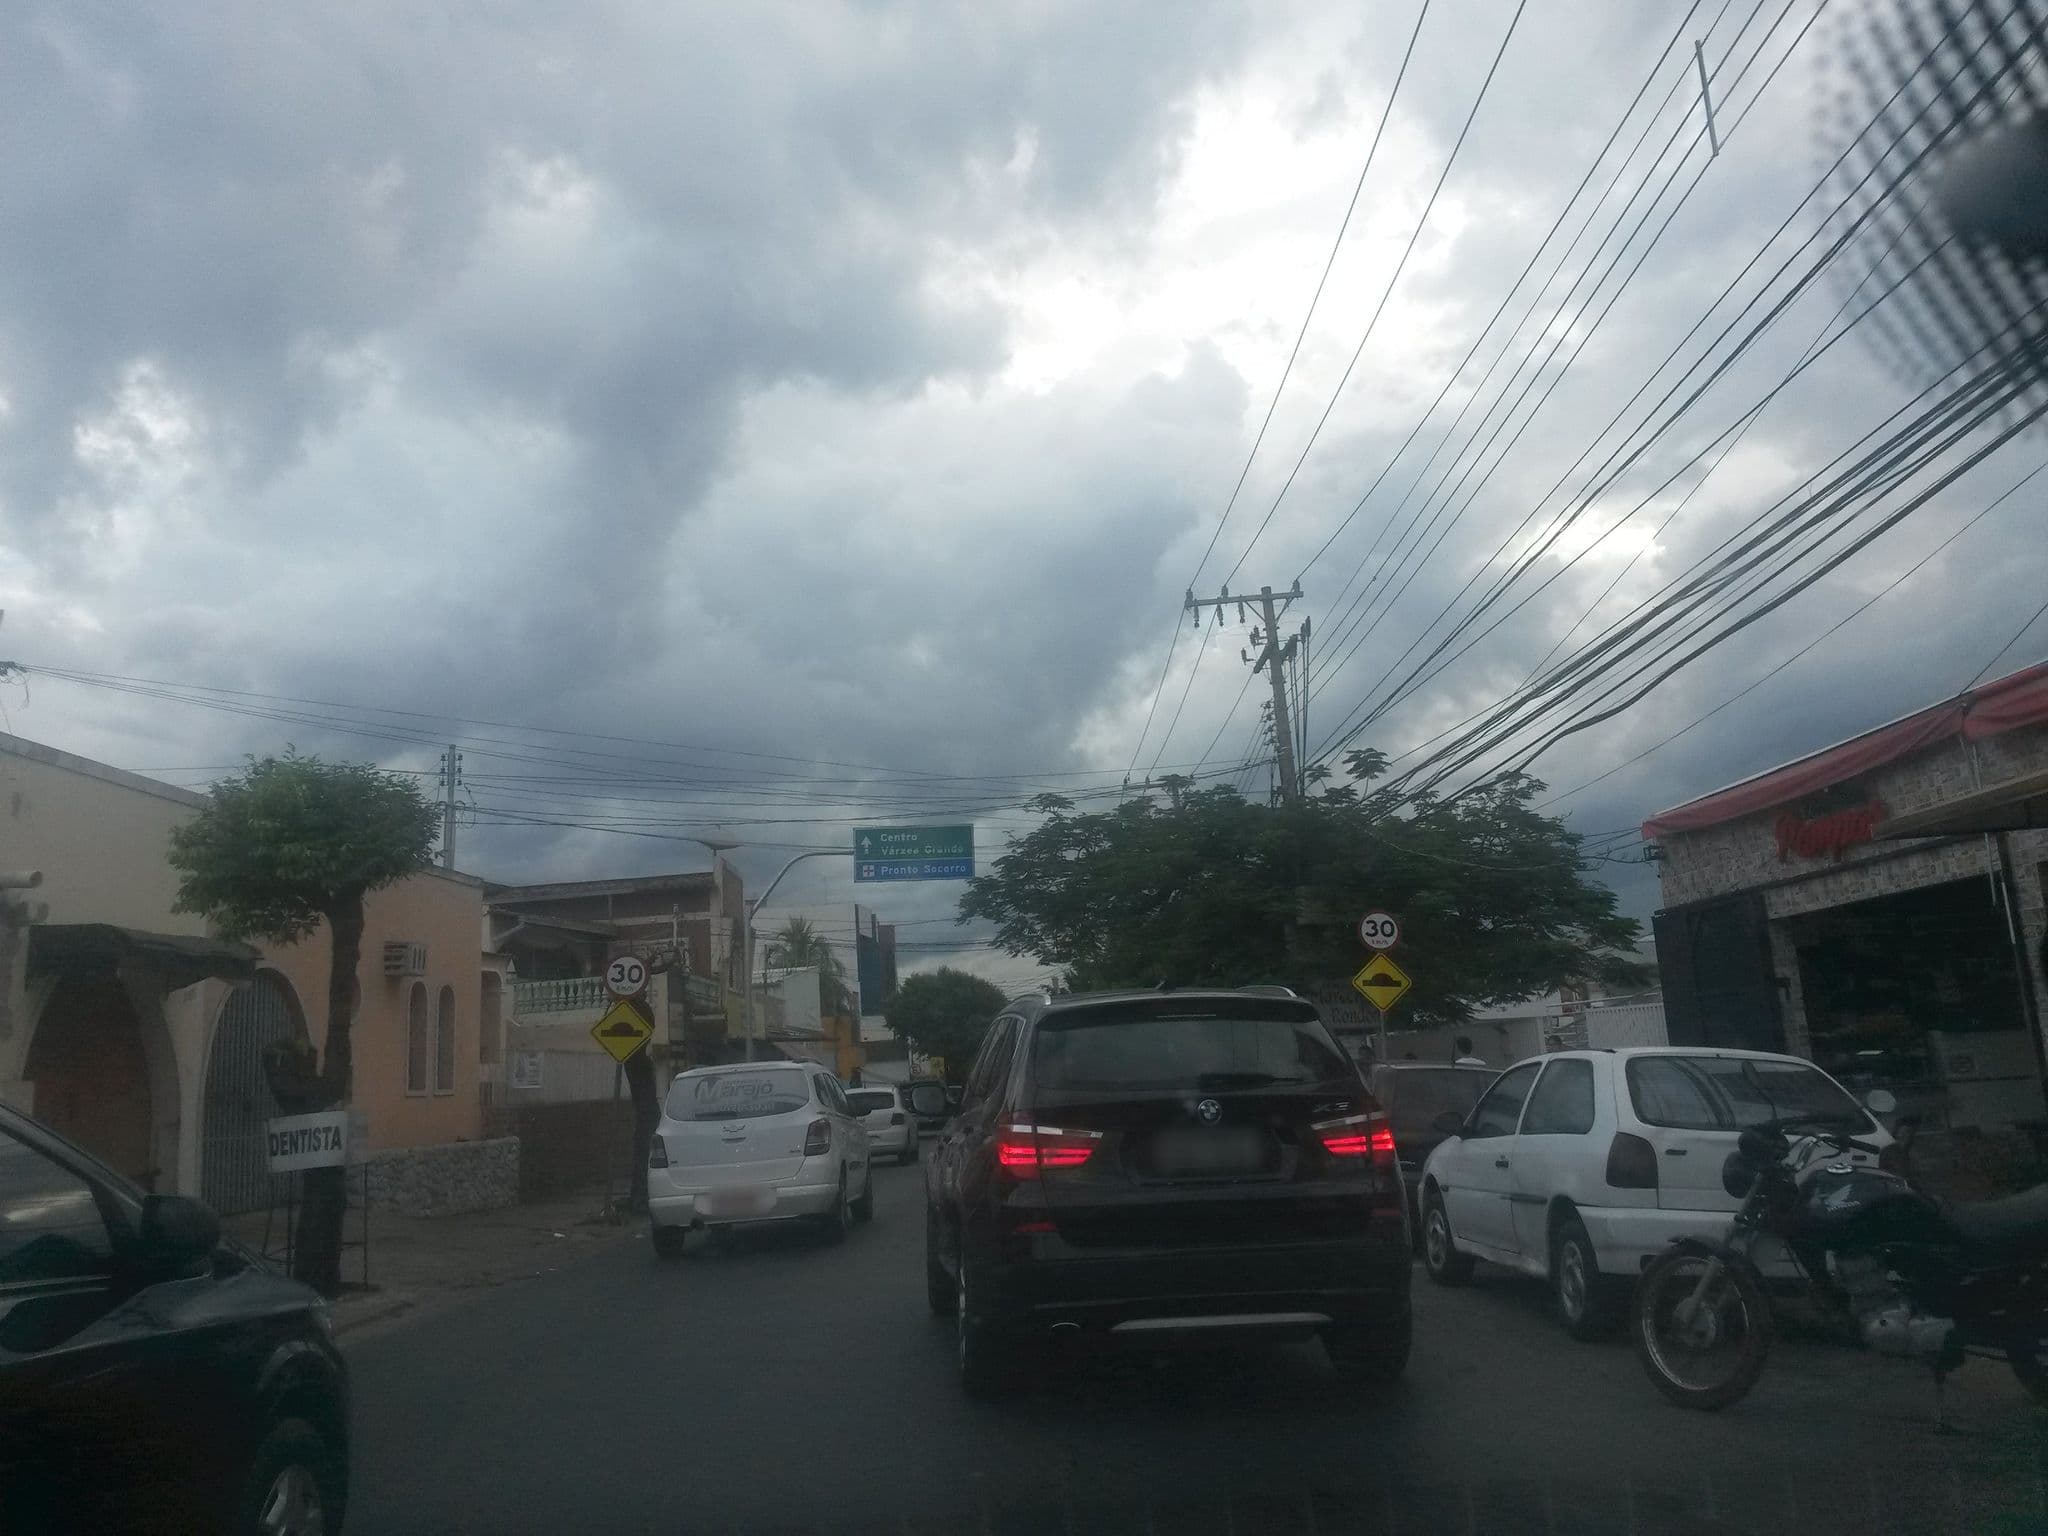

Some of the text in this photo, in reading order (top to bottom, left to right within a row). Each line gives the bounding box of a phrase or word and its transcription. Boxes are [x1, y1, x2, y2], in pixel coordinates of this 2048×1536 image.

[880, 833, 918, 842] Centro
[881, 864, 966, 875] Pronto Socorro
[1365, 920, 1395, 937] 30
[610, 964, 643, 983] 30
[270, 1125, 342, 1156] DENTISTA
